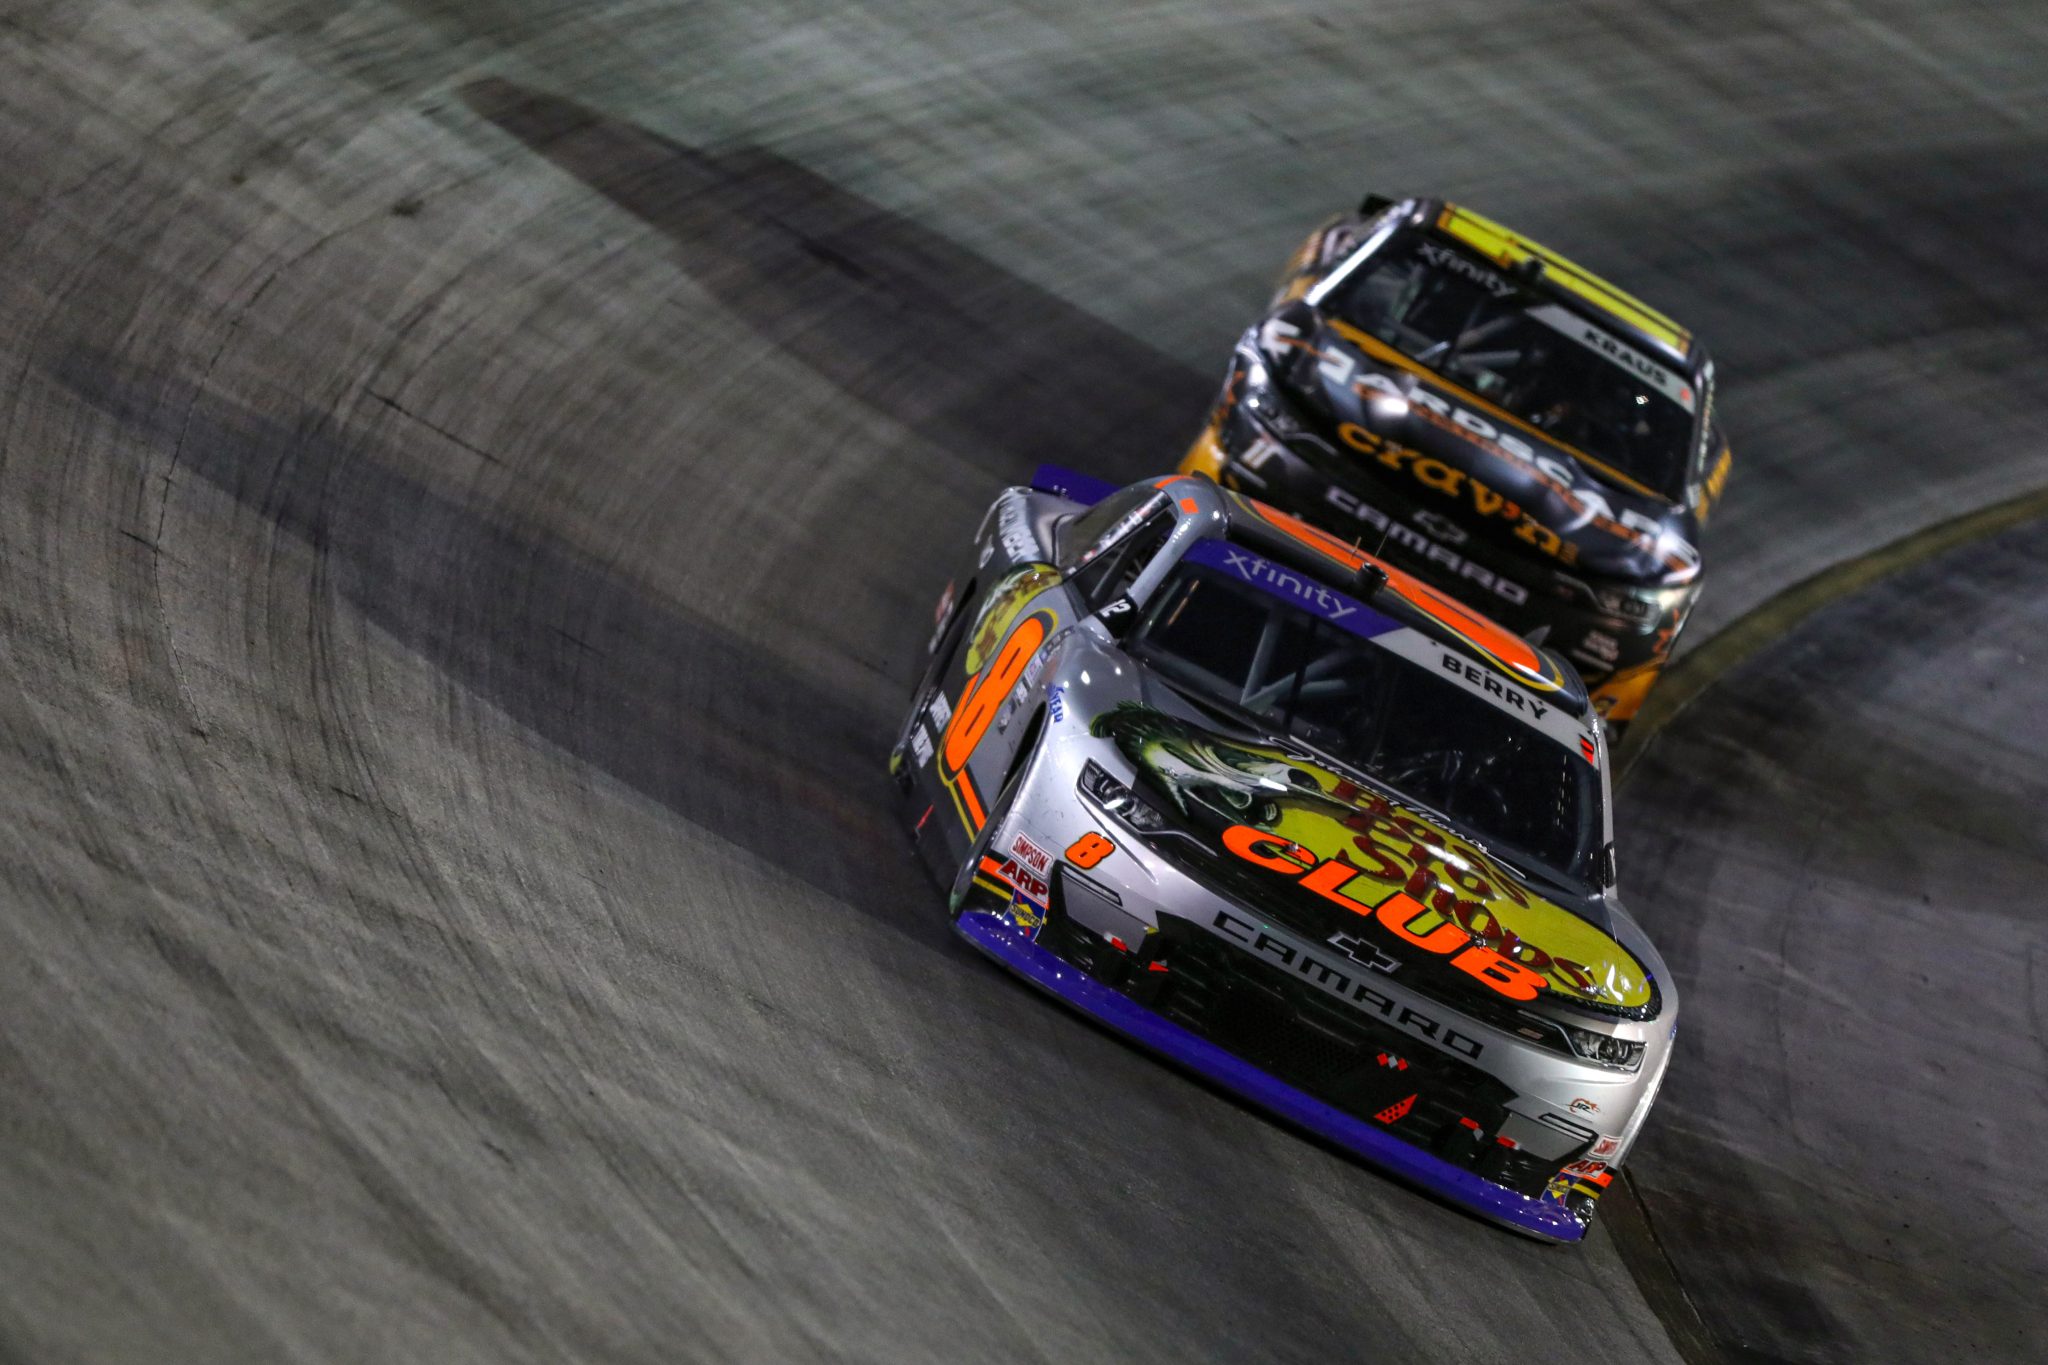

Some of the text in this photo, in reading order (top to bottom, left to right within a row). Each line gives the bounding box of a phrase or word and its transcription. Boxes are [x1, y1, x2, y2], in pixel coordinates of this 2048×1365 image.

[1415, 242, 1517, 300] xfinity
[1583, 327, 1670, 388] KRAUS
[1326, 485, 1530, 605] CAMARO
[1224, 549, 1358, 619] xfinity
[943, 616, 1046, 772] 8
[1441, 653, 1549, 721] BERRY
[1001, 861, 1048, 898] ARP
[1012, 836, 1050, 873] SIMPSON
[1065, 831, 1116, 870] 8
[1011, 903, 1041, 929] SUNOCO
[1221, 824, 1548, 1000] CLUB
[1212, 911, 1484, 1060] CAMARO
